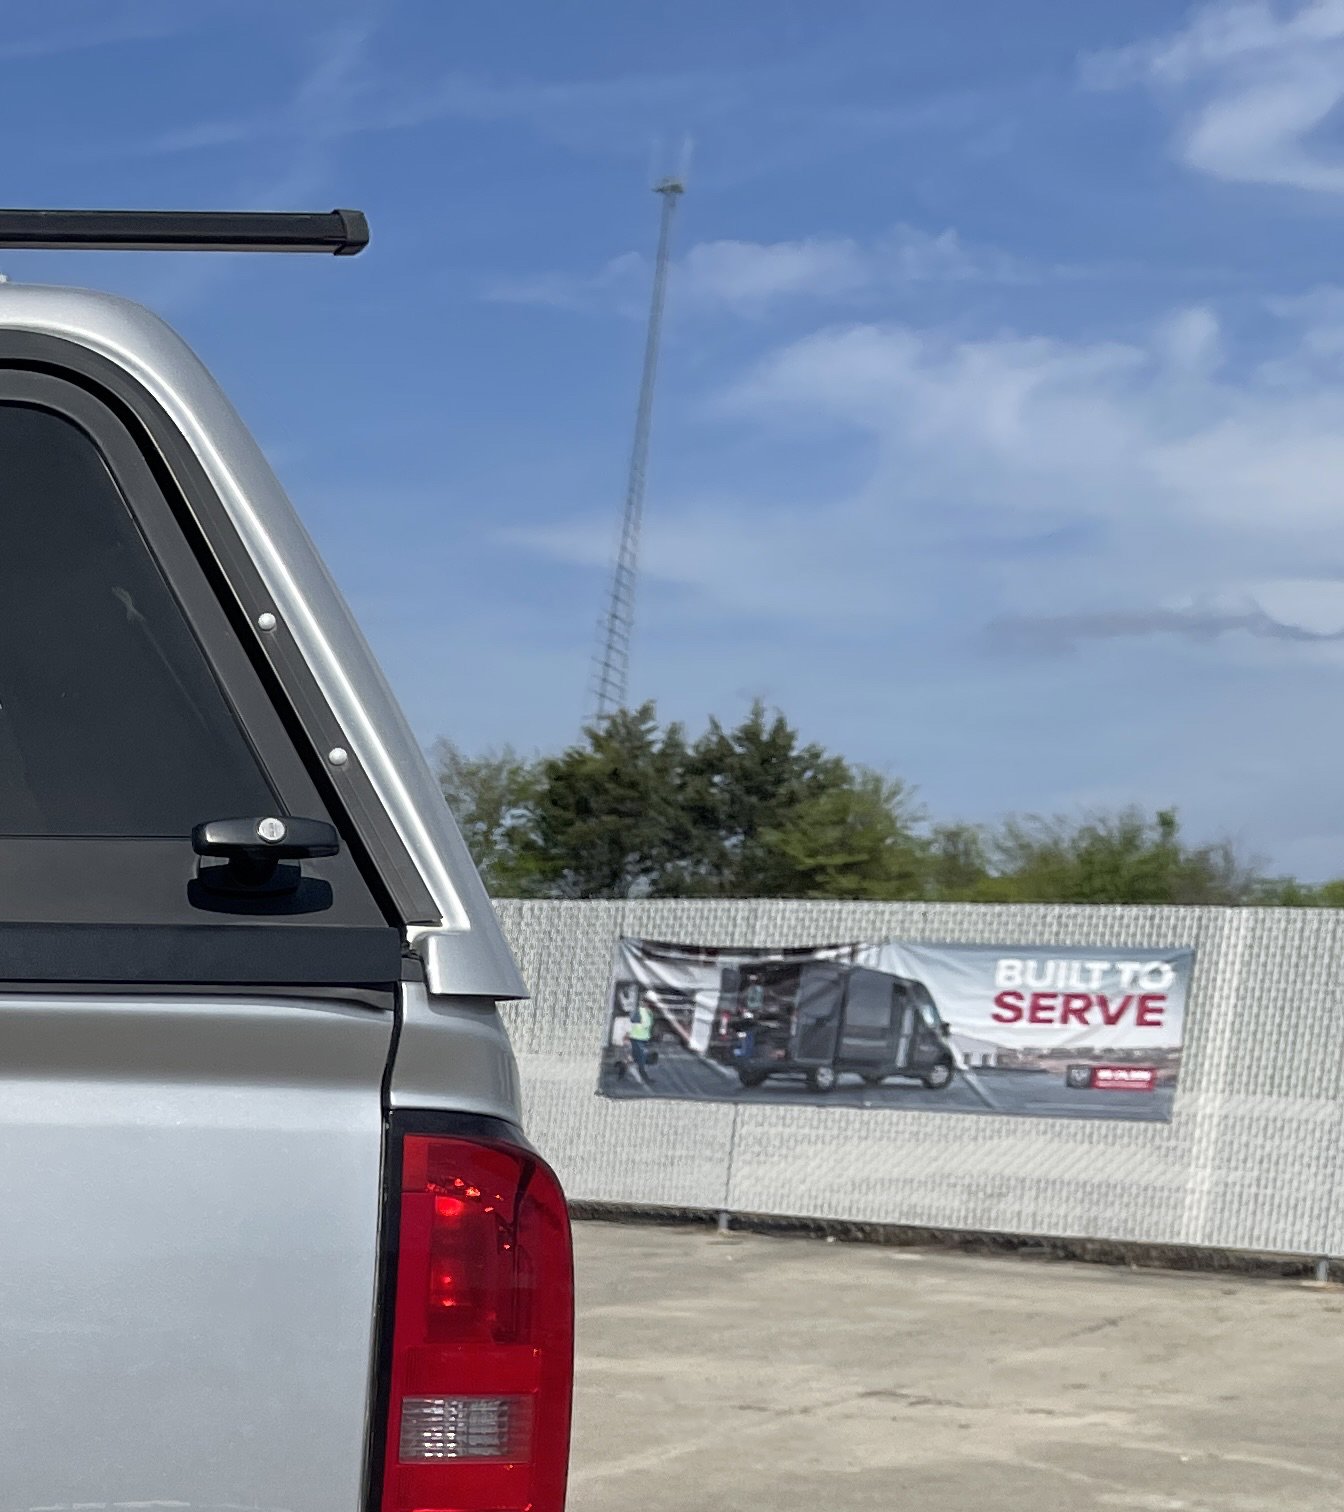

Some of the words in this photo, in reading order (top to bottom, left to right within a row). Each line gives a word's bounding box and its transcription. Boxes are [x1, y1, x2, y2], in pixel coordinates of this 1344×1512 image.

[995, 958, 1110, 989] BUILT
[1116, 961, 1175, 989] TO
[991, 990, 1167, 1026] SERVE
